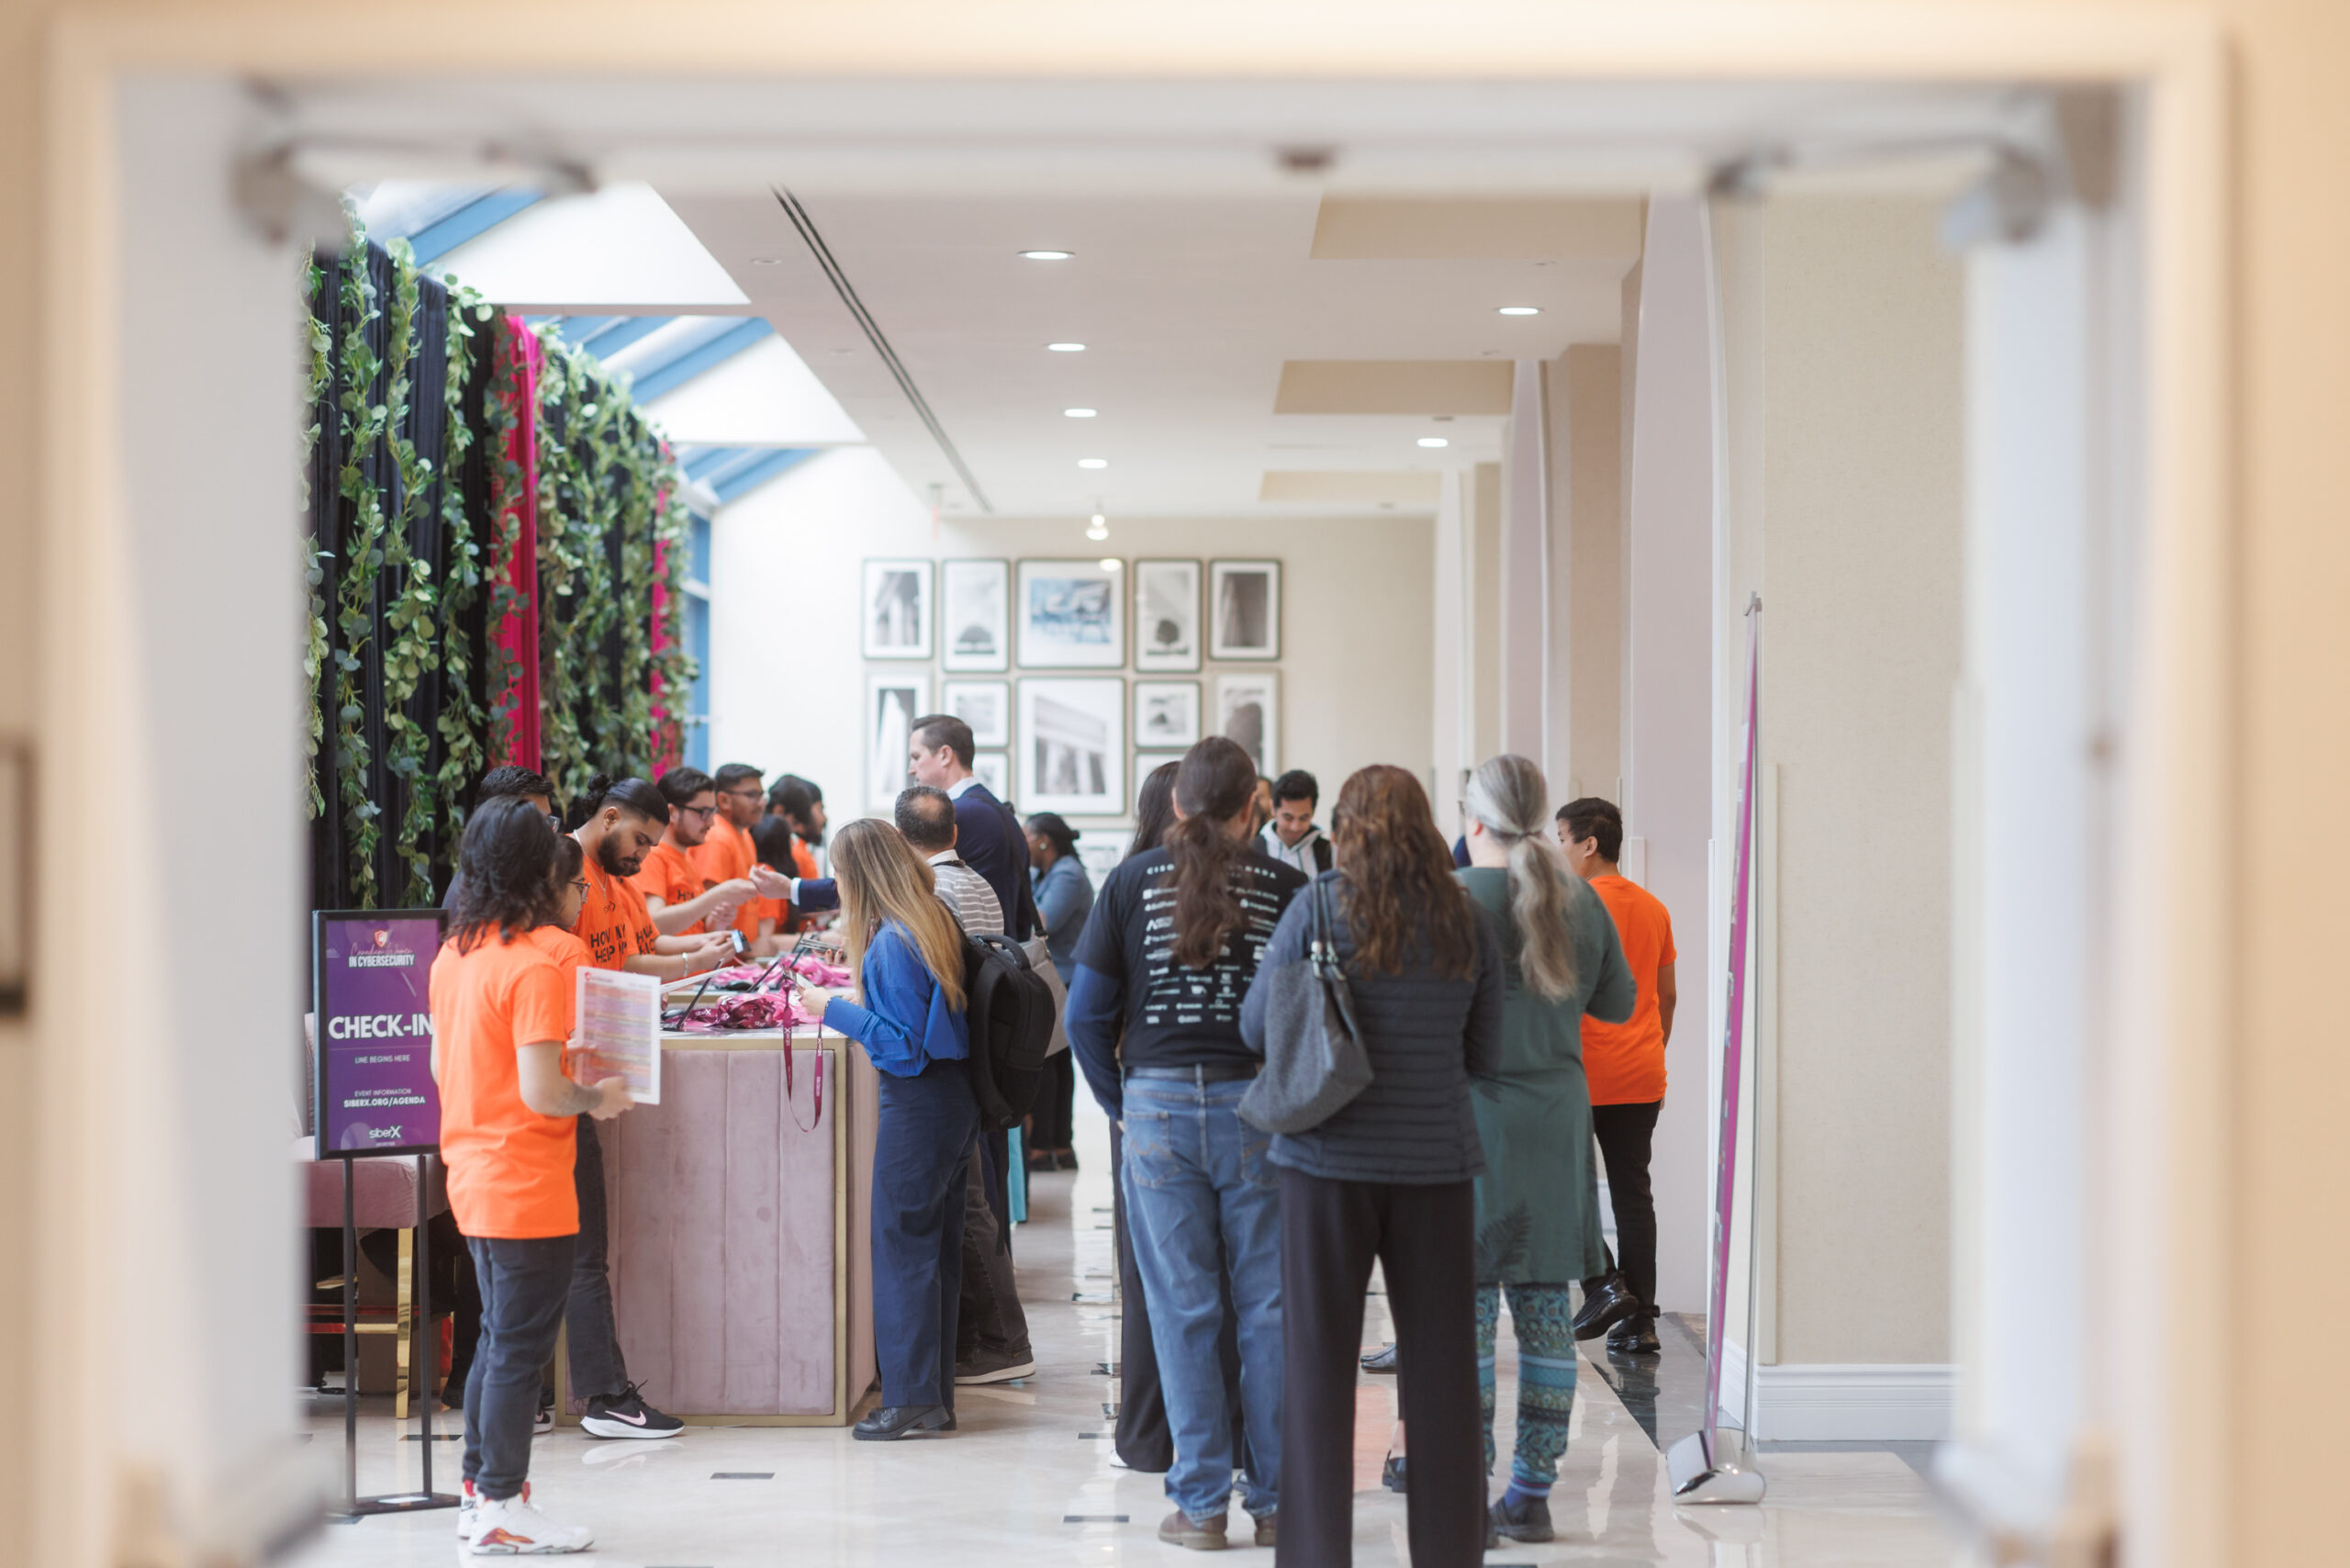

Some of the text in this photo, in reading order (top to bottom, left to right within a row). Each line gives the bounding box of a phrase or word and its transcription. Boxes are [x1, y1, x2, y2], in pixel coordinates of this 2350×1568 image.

[349, 954, 415, 968] IN CYBERSECURITY
[329, 1013, 434, 1040] CHECK-IN
[354, 1054, 410, 1064] LINE BEGINS HERE
[373, 1088, 411, 1096] INFORMATION
[343, 1095, 426, 1108] SIBERX.ORG/AGENDA
[368, 1125, 402, 1139] siberX
